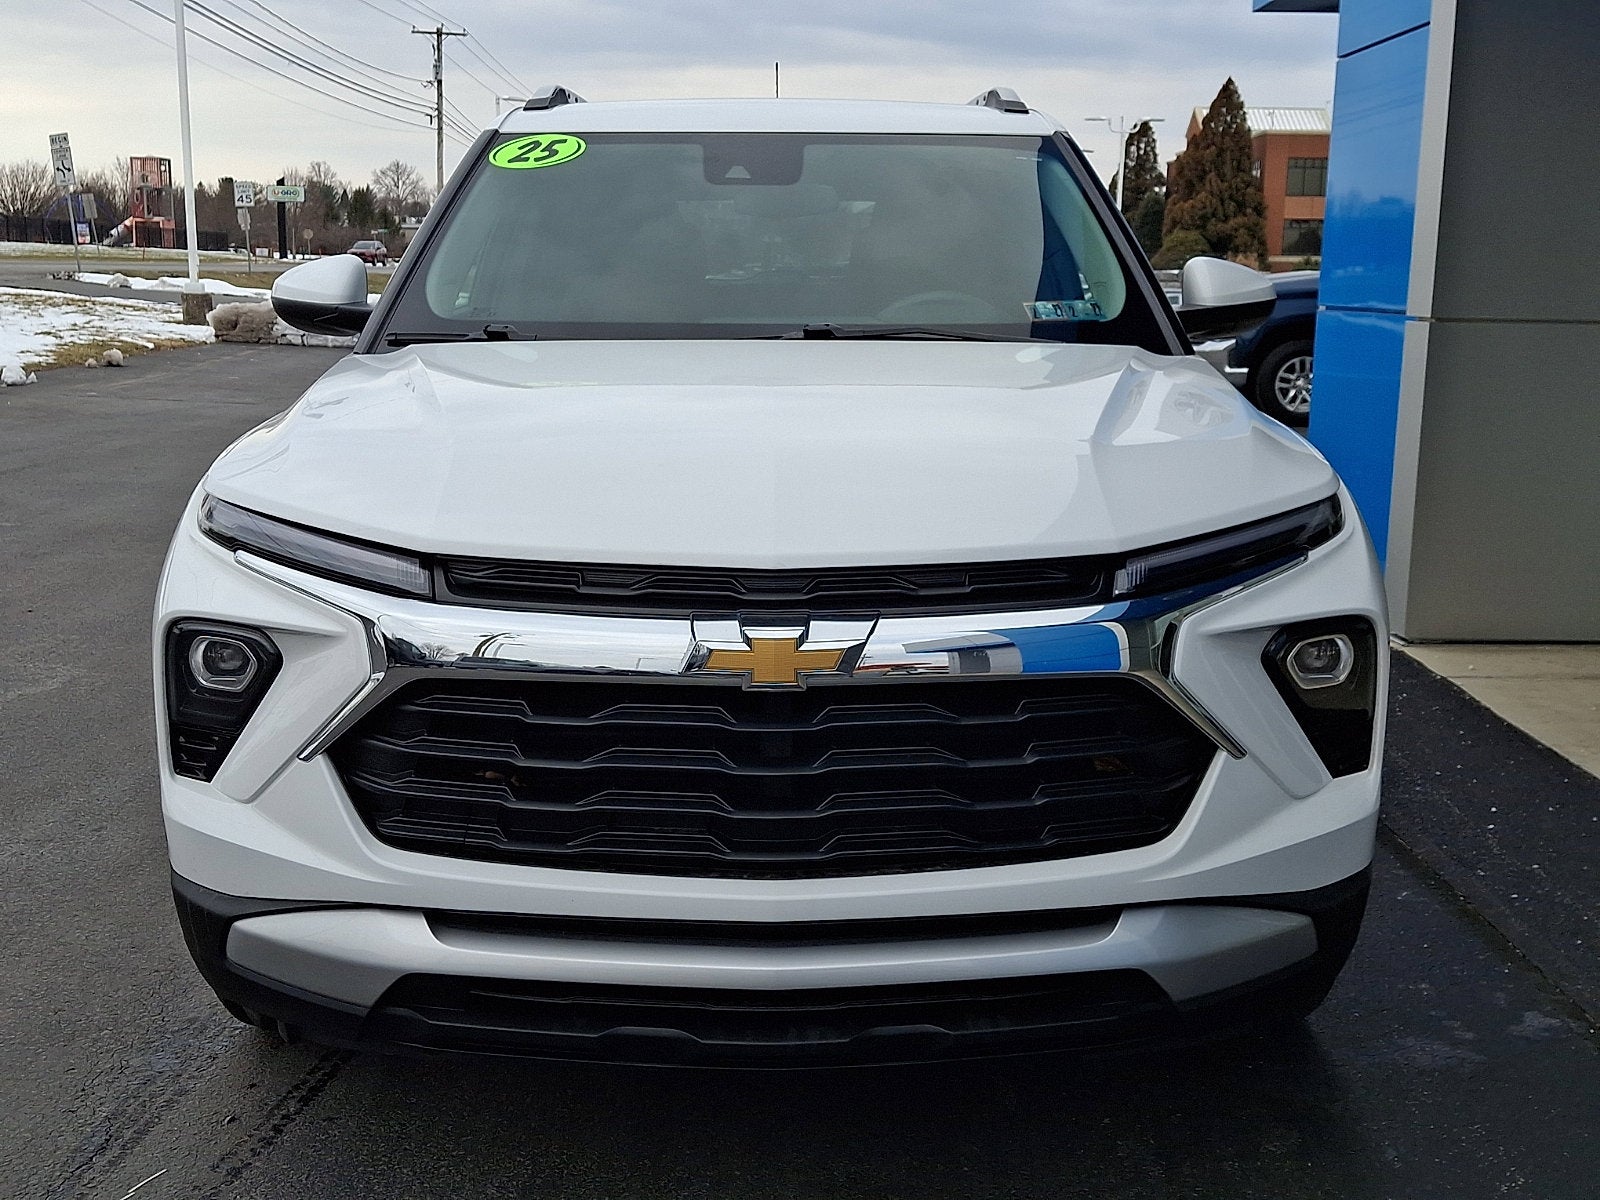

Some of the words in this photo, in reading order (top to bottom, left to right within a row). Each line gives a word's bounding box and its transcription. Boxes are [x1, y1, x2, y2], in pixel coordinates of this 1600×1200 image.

[51, 136, 68, 145] BEGIN
[507, 139, 568, 163] 25
[237, 195, 252, 204] 45
